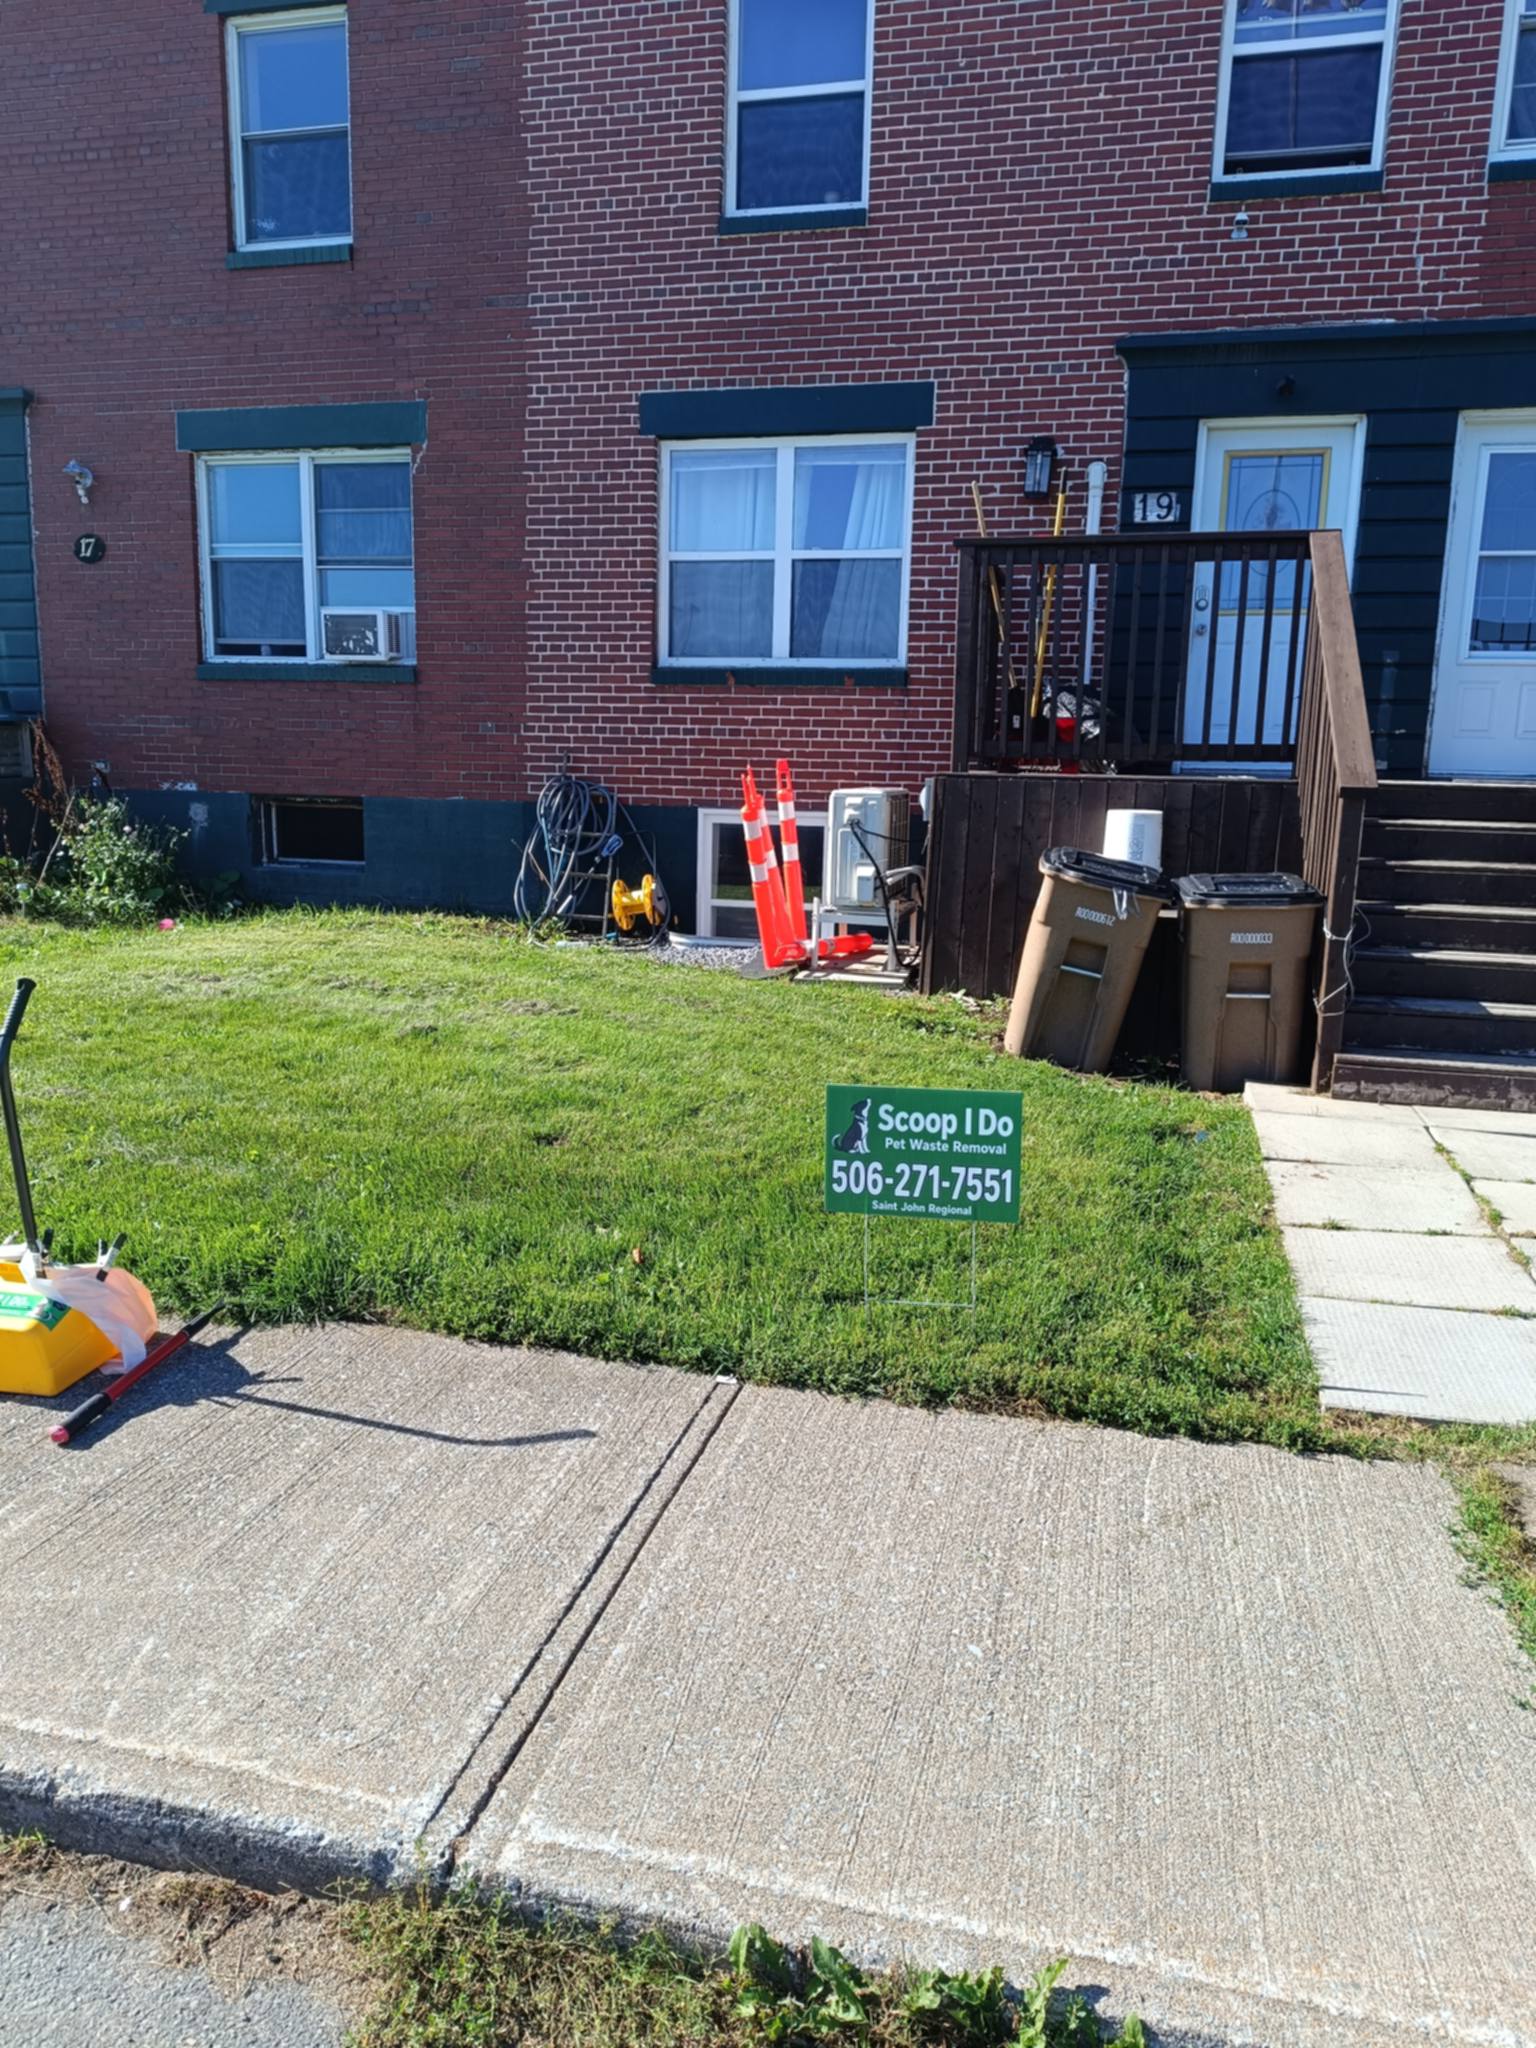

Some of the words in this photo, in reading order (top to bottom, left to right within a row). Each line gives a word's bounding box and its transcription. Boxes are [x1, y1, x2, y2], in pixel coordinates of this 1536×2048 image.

[1139, 492, 1173, 520] 19
[80, 537, 96, 557] 17
[877, 1103, 958, 1140] Scoop
[965, 1107, 973, 1135] I
[978, 1108, 1014, 1137] Do
[885, 1137, 906, 1150] Pet
[910, 1138, 949, 1152] Waste
[953, 1141, 1007, 1155] Removal
[831, 1159, 1012, 1203] 506-271-7551
[872, 1200, 898, 1211] Saint
[900, 1202, 926, 1213] John
[928, 1203, 972, 1216] Regional
